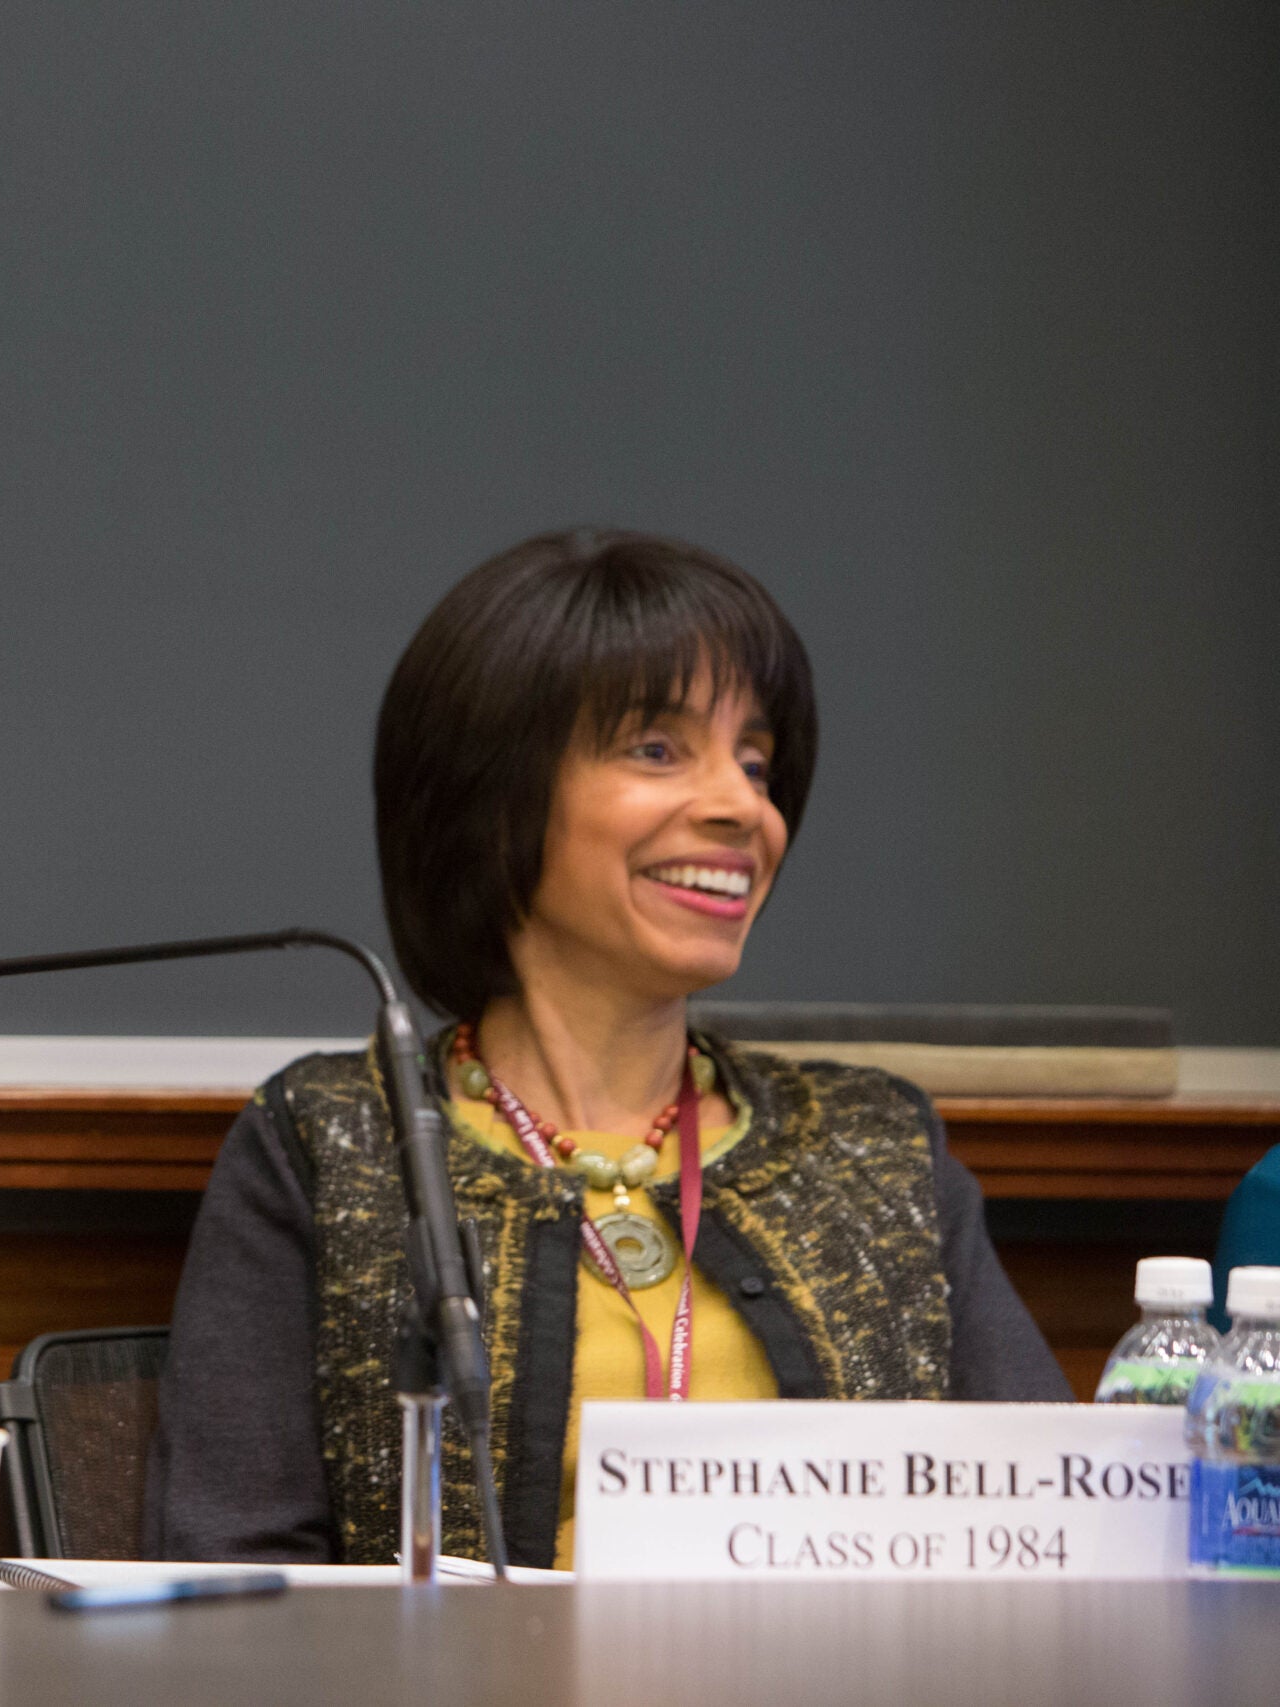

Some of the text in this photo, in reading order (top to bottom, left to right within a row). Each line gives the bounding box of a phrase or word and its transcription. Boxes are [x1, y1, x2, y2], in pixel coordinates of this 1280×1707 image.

[522, 1131, 556, 1169] arvard
[670, 1317, 689, 1389] Celebration
[597, 1448, 1192, 1501] STEPHANIE BELL-ROSE
[1221, 1490, 1280, 1531] AQUA
[726, 1524, 1070, 1570] CLASS OF 1984
